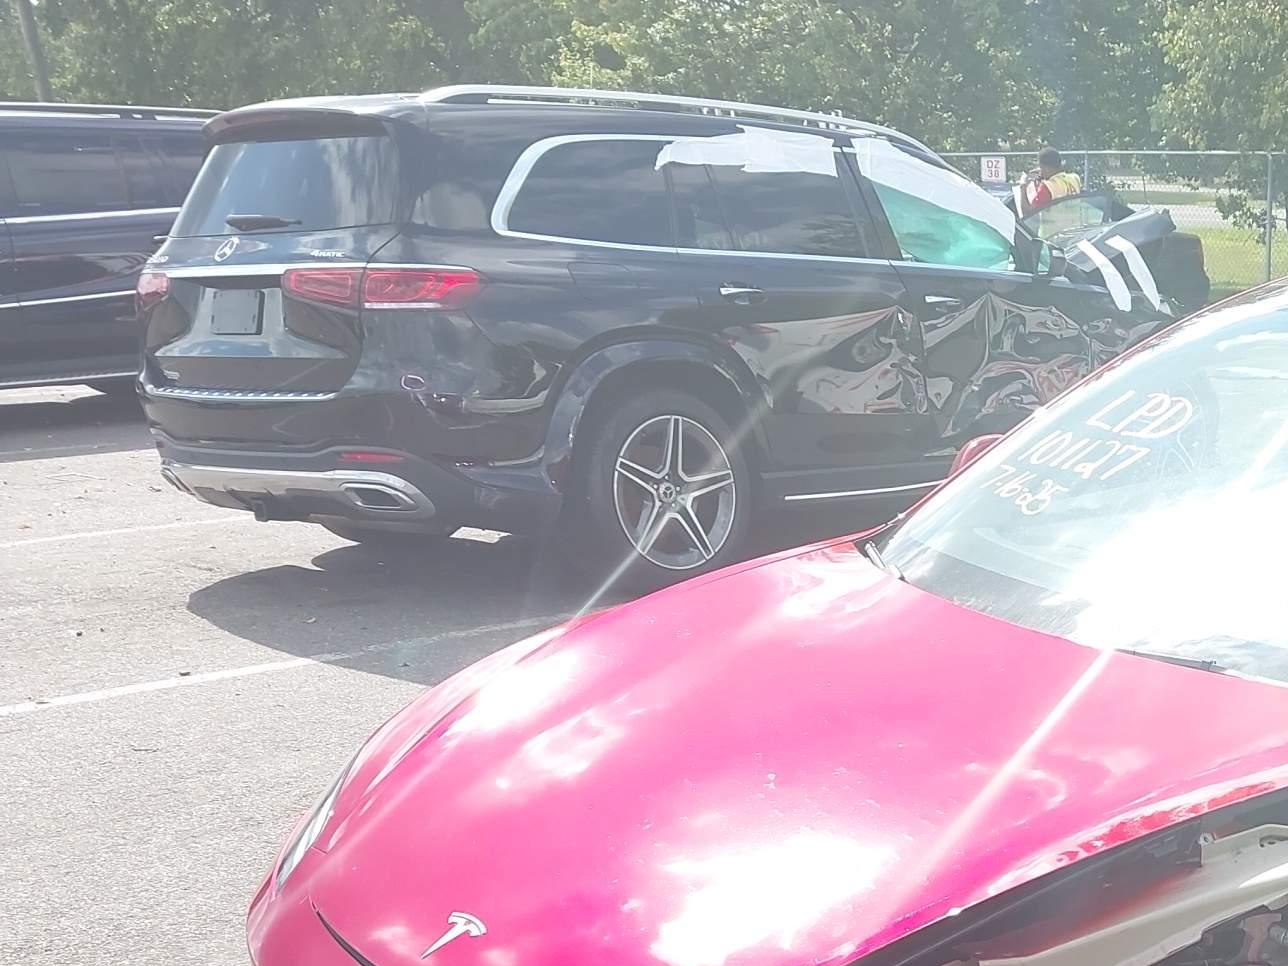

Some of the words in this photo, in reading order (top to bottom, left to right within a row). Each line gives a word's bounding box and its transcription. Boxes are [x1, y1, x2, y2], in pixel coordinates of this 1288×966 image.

[986, 159, 1001, 169] DZ
[1086, 389, 1193, 438] LPD
[1017, 430, 1151, 480] 101127
